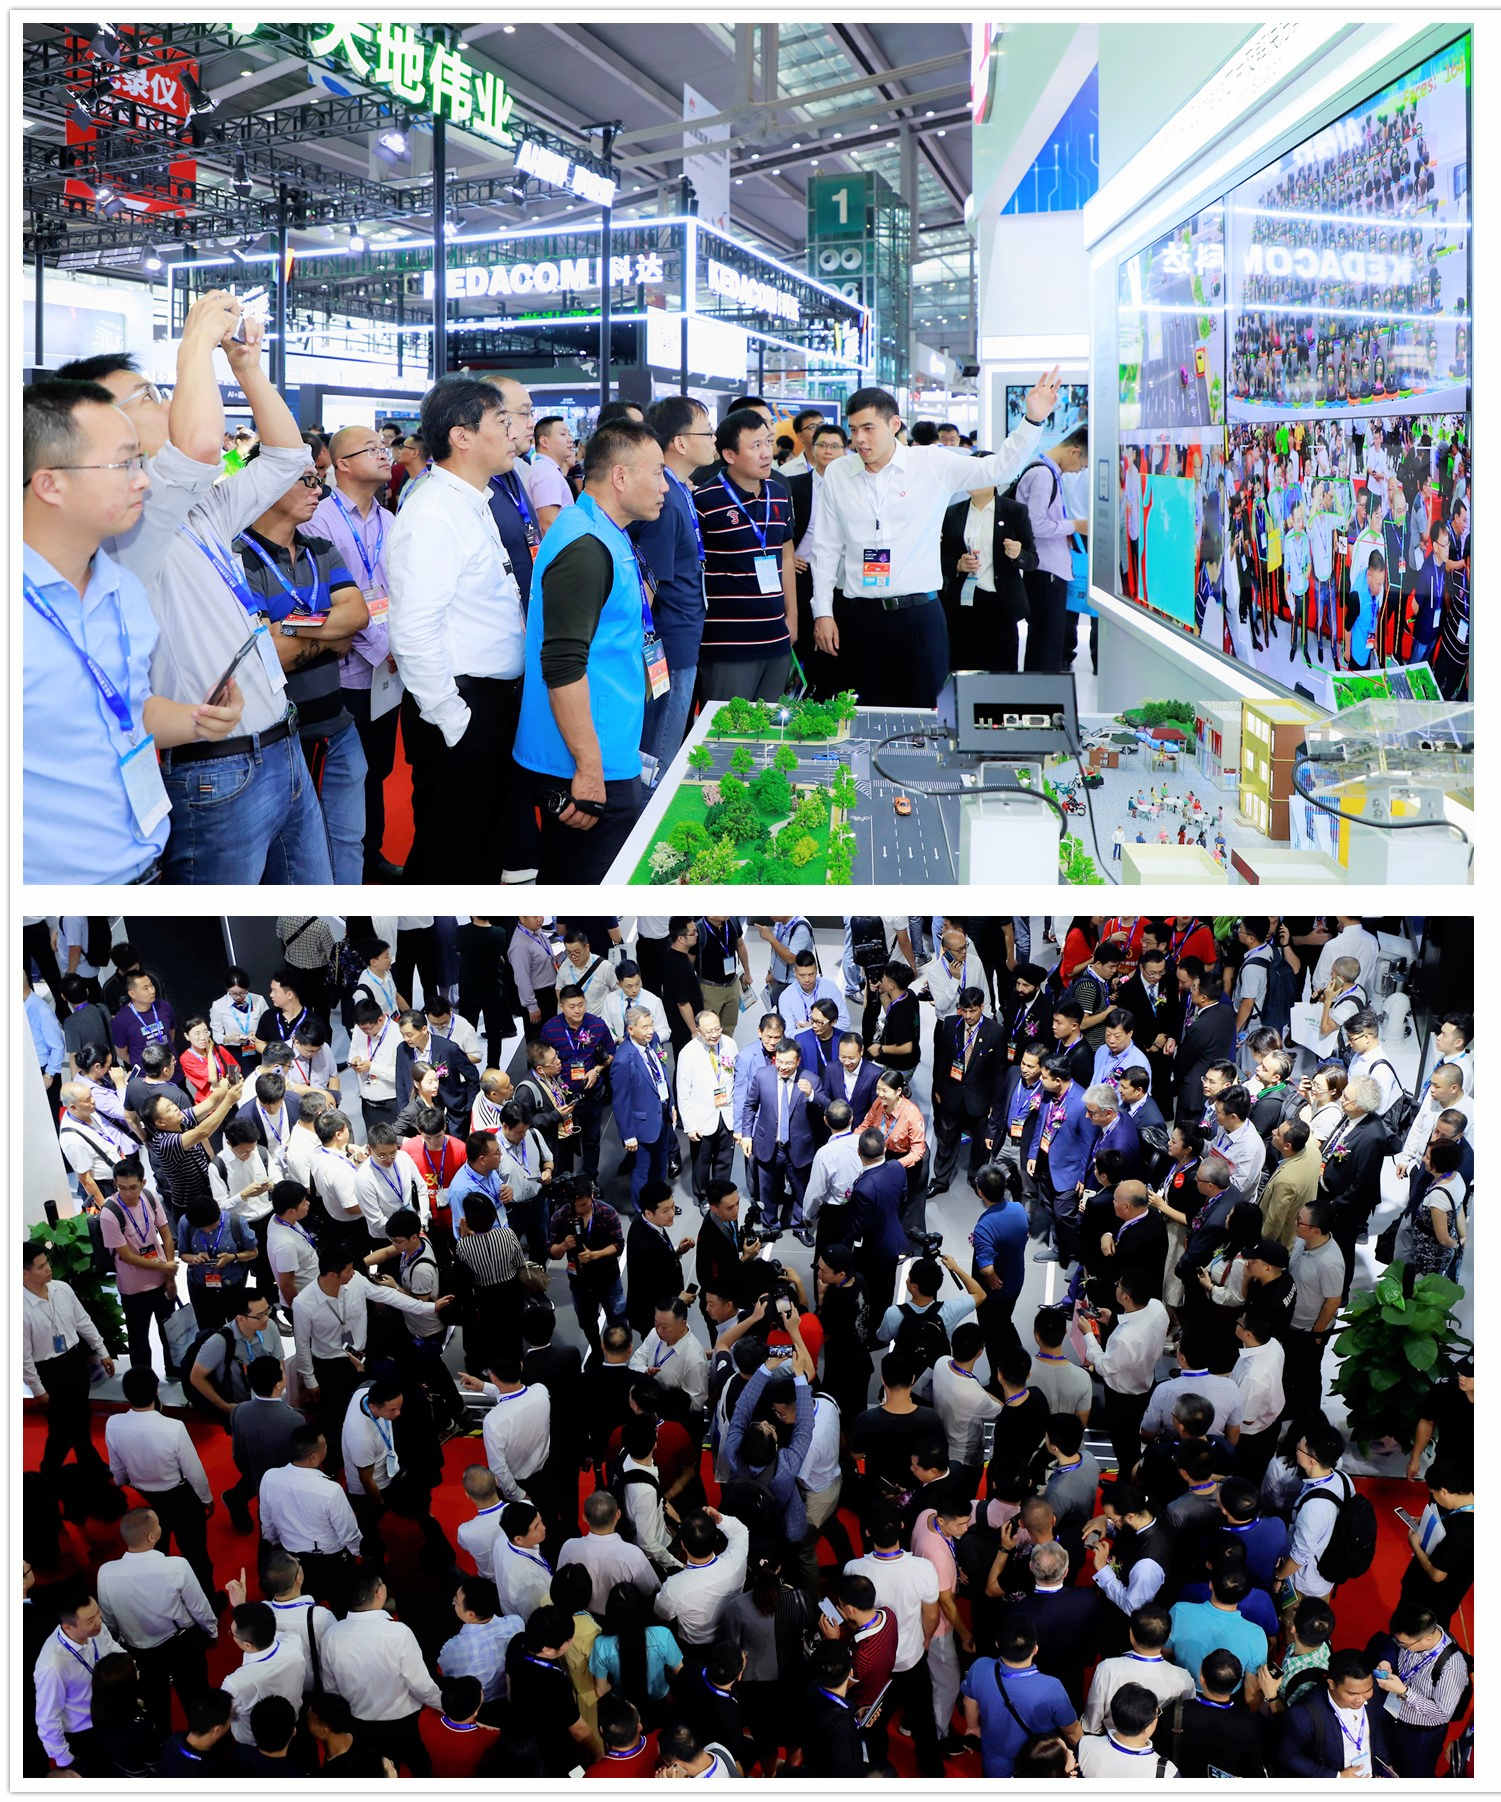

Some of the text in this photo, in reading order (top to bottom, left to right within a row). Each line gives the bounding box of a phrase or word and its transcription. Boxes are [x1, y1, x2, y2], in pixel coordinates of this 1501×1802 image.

[310, 22, 518, 146] 天地伟业
[832, 188, 848, 224] 1
[609, 252, 664, 287] 科达
